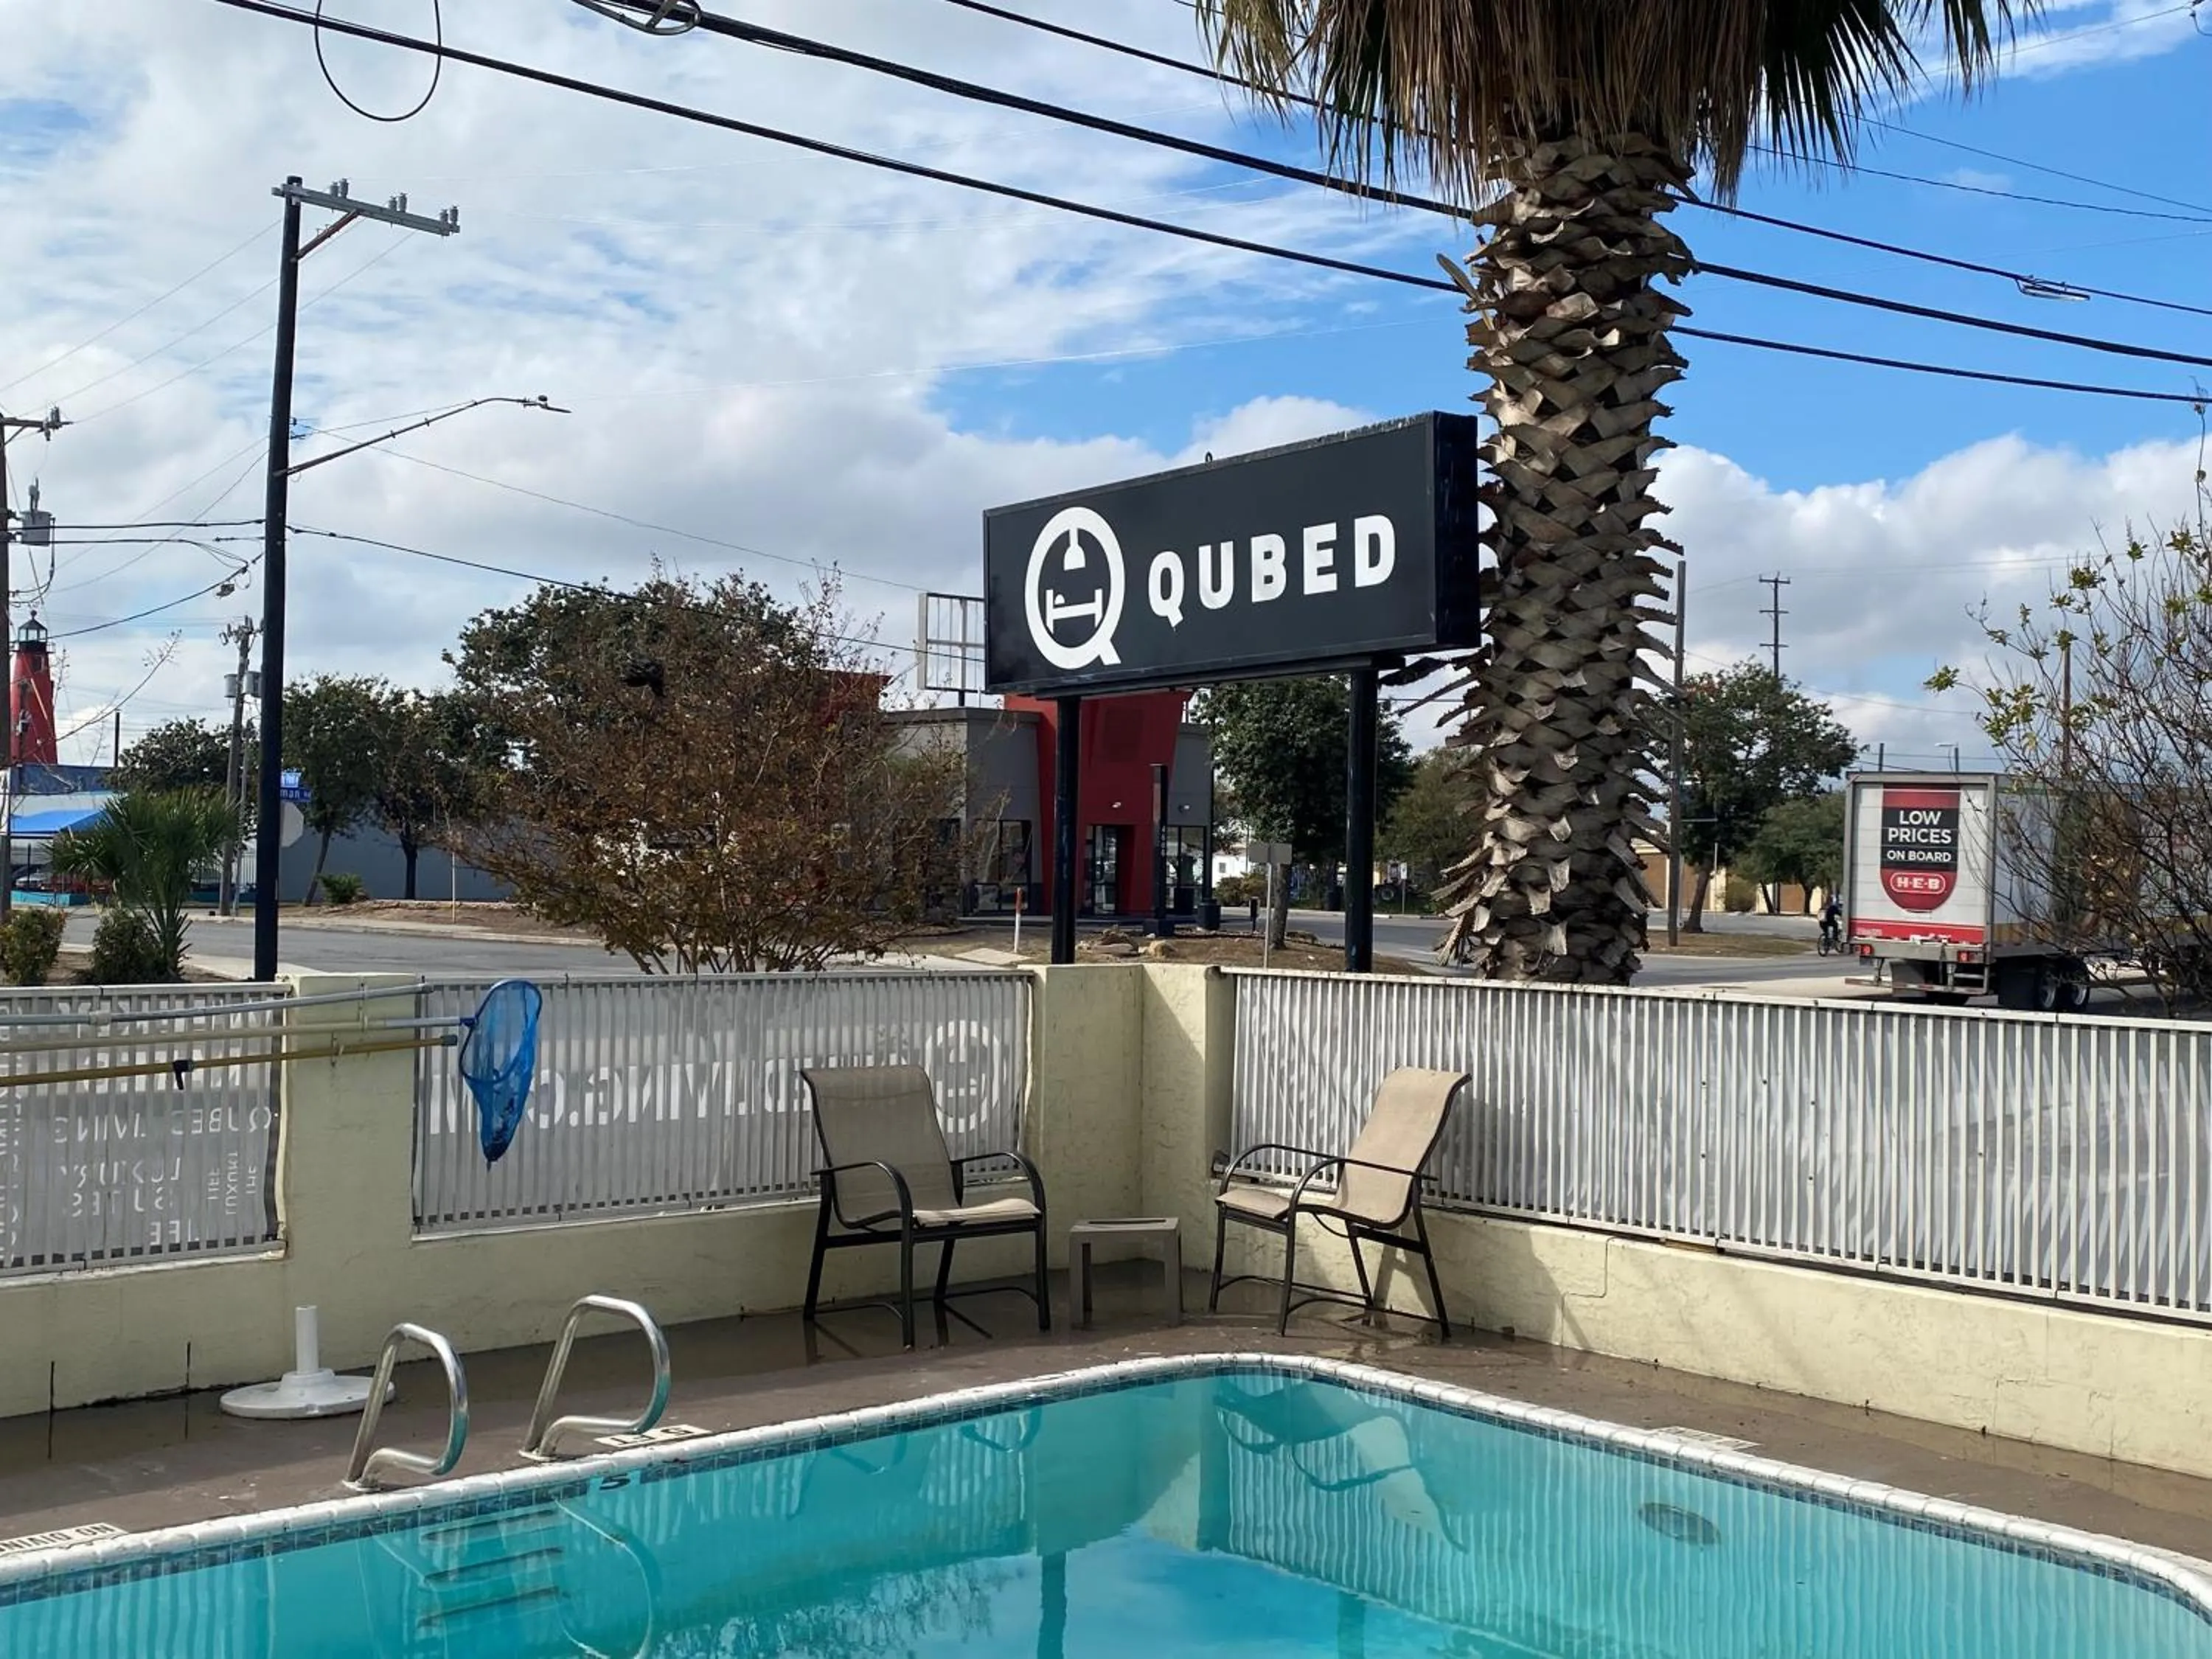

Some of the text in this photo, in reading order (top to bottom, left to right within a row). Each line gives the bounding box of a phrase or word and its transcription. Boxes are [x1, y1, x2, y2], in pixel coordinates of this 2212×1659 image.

[1148, 515, 1396, 627] QUBED
[1899, 810, 1941, 825] LOW
[1888, 827, 1952, 844] PRICES
[1888, 850, 1952, 862] ON BOARD
[75, 1525, 114, 1536] NO
